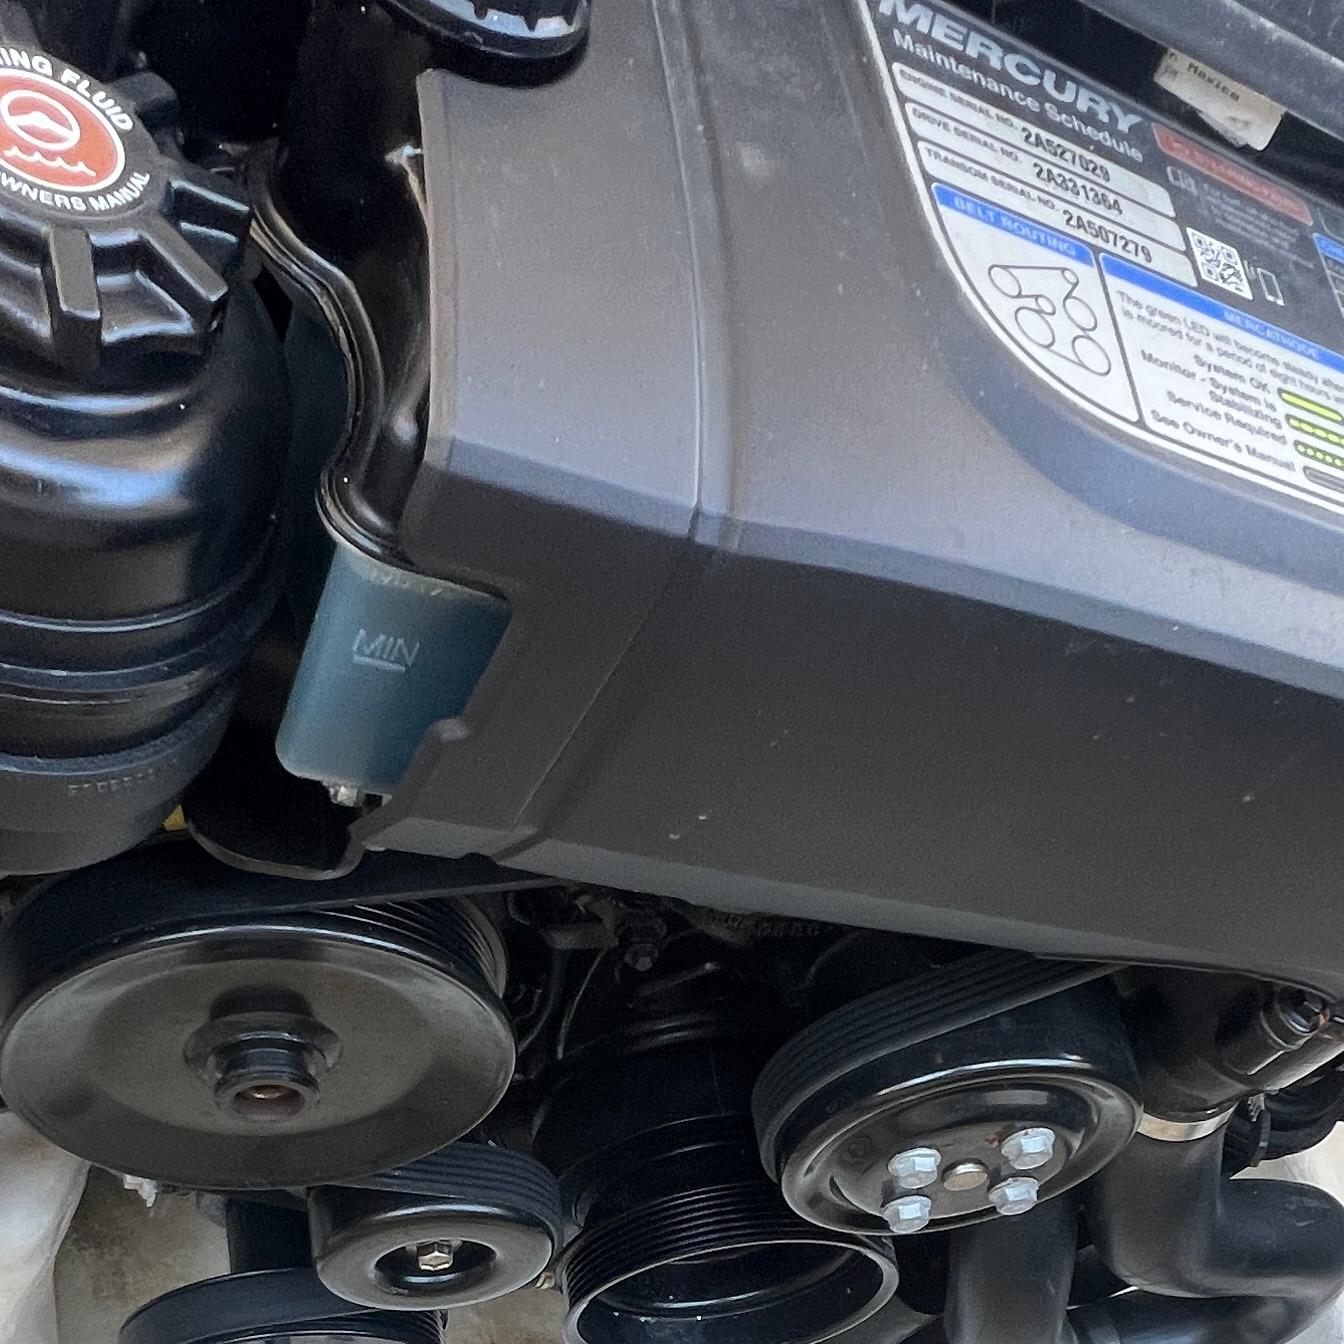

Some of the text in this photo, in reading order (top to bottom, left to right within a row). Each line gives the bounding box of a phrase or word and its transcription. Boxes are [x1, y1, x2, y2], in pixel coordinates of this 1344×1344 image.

[879, 0, 1143, 133] MERCURY
[893, 28, 1143, 162] Maintenance Schedule
[1187, 63, 1240, 101] Mexico
[61, 68, 133, 131] FLUID
[949, 91, 993, 119] SERIAL
[1019, 124, 1111, 183] 2A527029
[89, 172, 150, 211] MANUAL
[951, 192, 1078, 260] BELT ROUTING
[1061, 207, 1153, 265] 2A507279
[1116, 289, 1144, 312] The
[1144, 302, 1183, 329] green
[1182, 314, 1210, 338] LED
[1139, 348, 1198, 384] Monitor
[1208, 376, 1263, 410] System
[1192, 352, 1271, 395] System OK
[1165, 388, 1289, 450] Service Required
[1207, 387, 1283, 431] Stabilizing
[1149, 407, 1297, 475] See Owner's Manual
[353, 629, 420, 667] MIN
